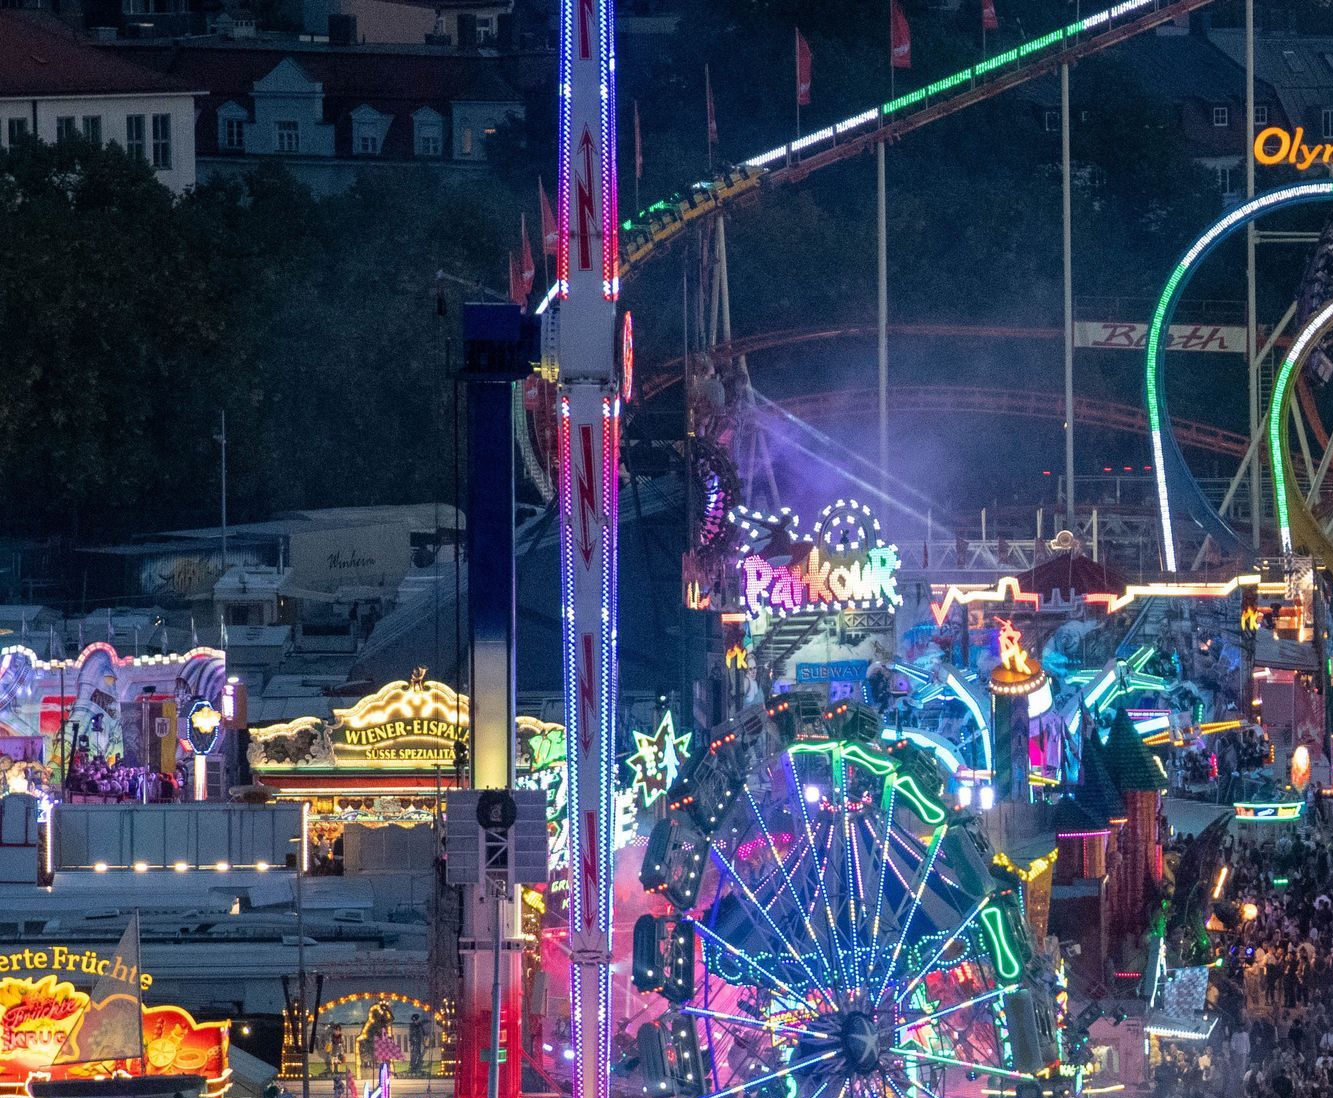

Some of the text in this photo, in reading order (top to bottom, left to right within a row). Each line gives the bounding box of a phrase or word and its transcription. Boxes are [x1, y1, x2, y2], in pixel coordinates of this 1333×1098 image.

[800, 665, 861, 680] SUBWAY
[365, 748, 397, 760] SÜSSE
[51, 946, 153, 990] Früchte
[4, 998, 77, 1028] Früchte
